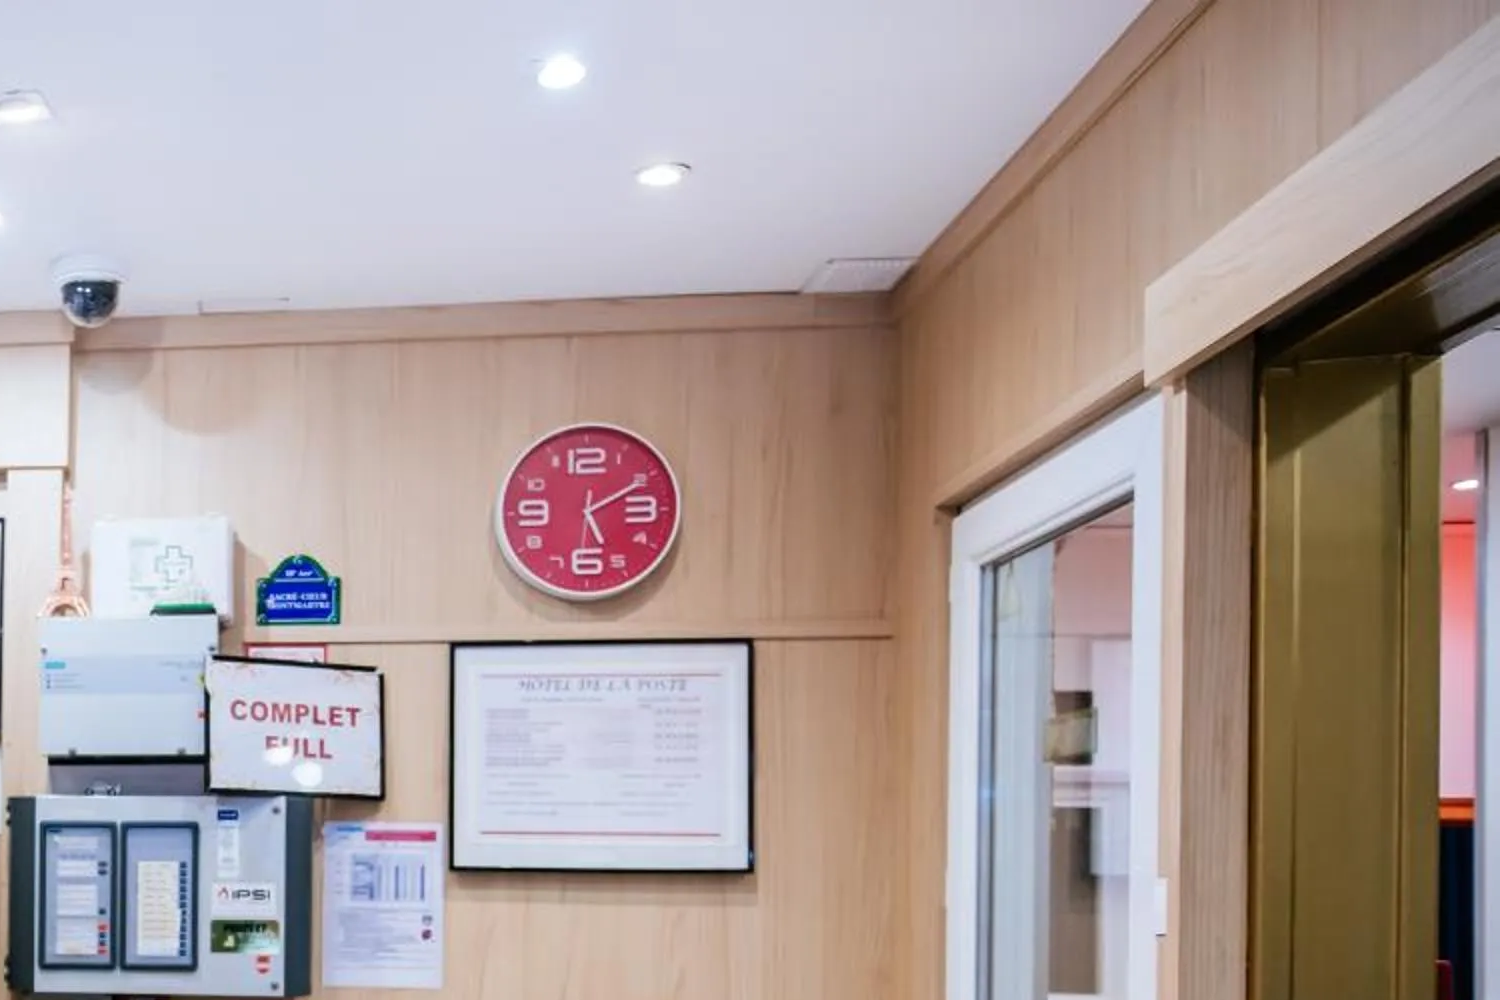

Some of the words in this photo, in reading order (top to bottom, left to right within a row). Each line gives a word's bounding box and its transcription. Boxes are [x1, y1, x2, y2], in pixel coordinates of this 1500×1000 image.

[567, 448, 607, 474] 12
[518, 499, 549, 527] 9
[625, 496, 657, 523] 3
[526, 535, 542, 549] 8
[633, 532, 647, 545] 4
[550, 556, 564, 569] 7
[571, 548, 603, 575] 6
[610, 555, 626, 568] 5
[230, 699, 361, 727] COMPLET
[265, 736, 333, 759] FULL
